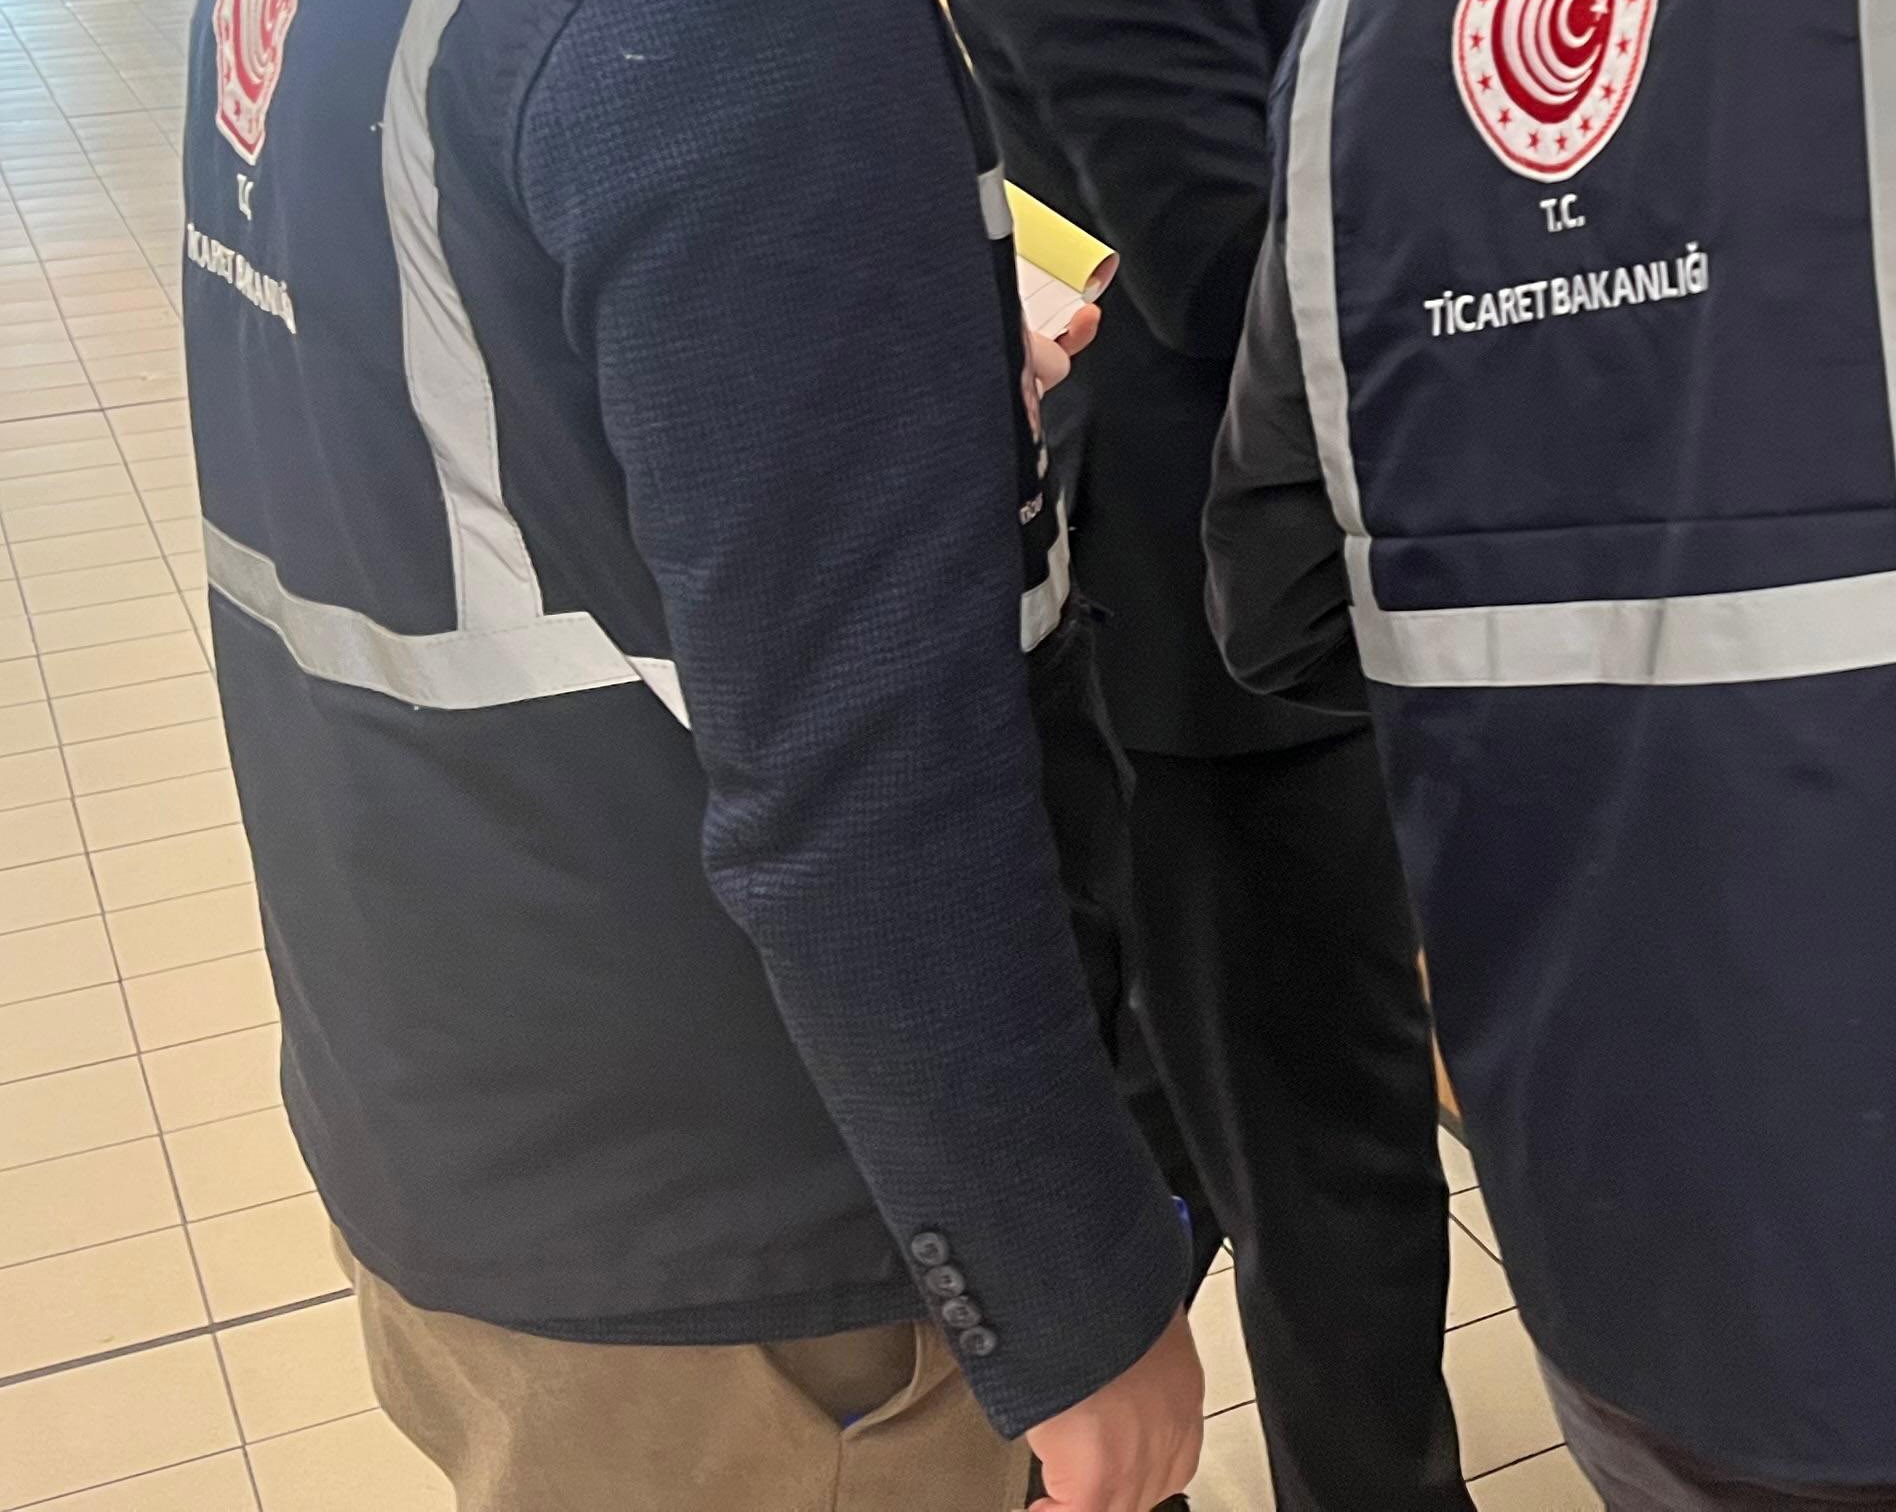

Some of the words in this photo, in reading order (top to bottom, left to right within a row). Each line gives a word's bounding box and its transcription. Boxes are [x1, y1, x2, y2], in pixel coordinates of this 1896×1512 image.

[1540, 194, 1585, 232] T.C.
[1424, 281, 1548, 336] TİCARET
[1551, 243, 1709, 316] BAKANLIĞI
